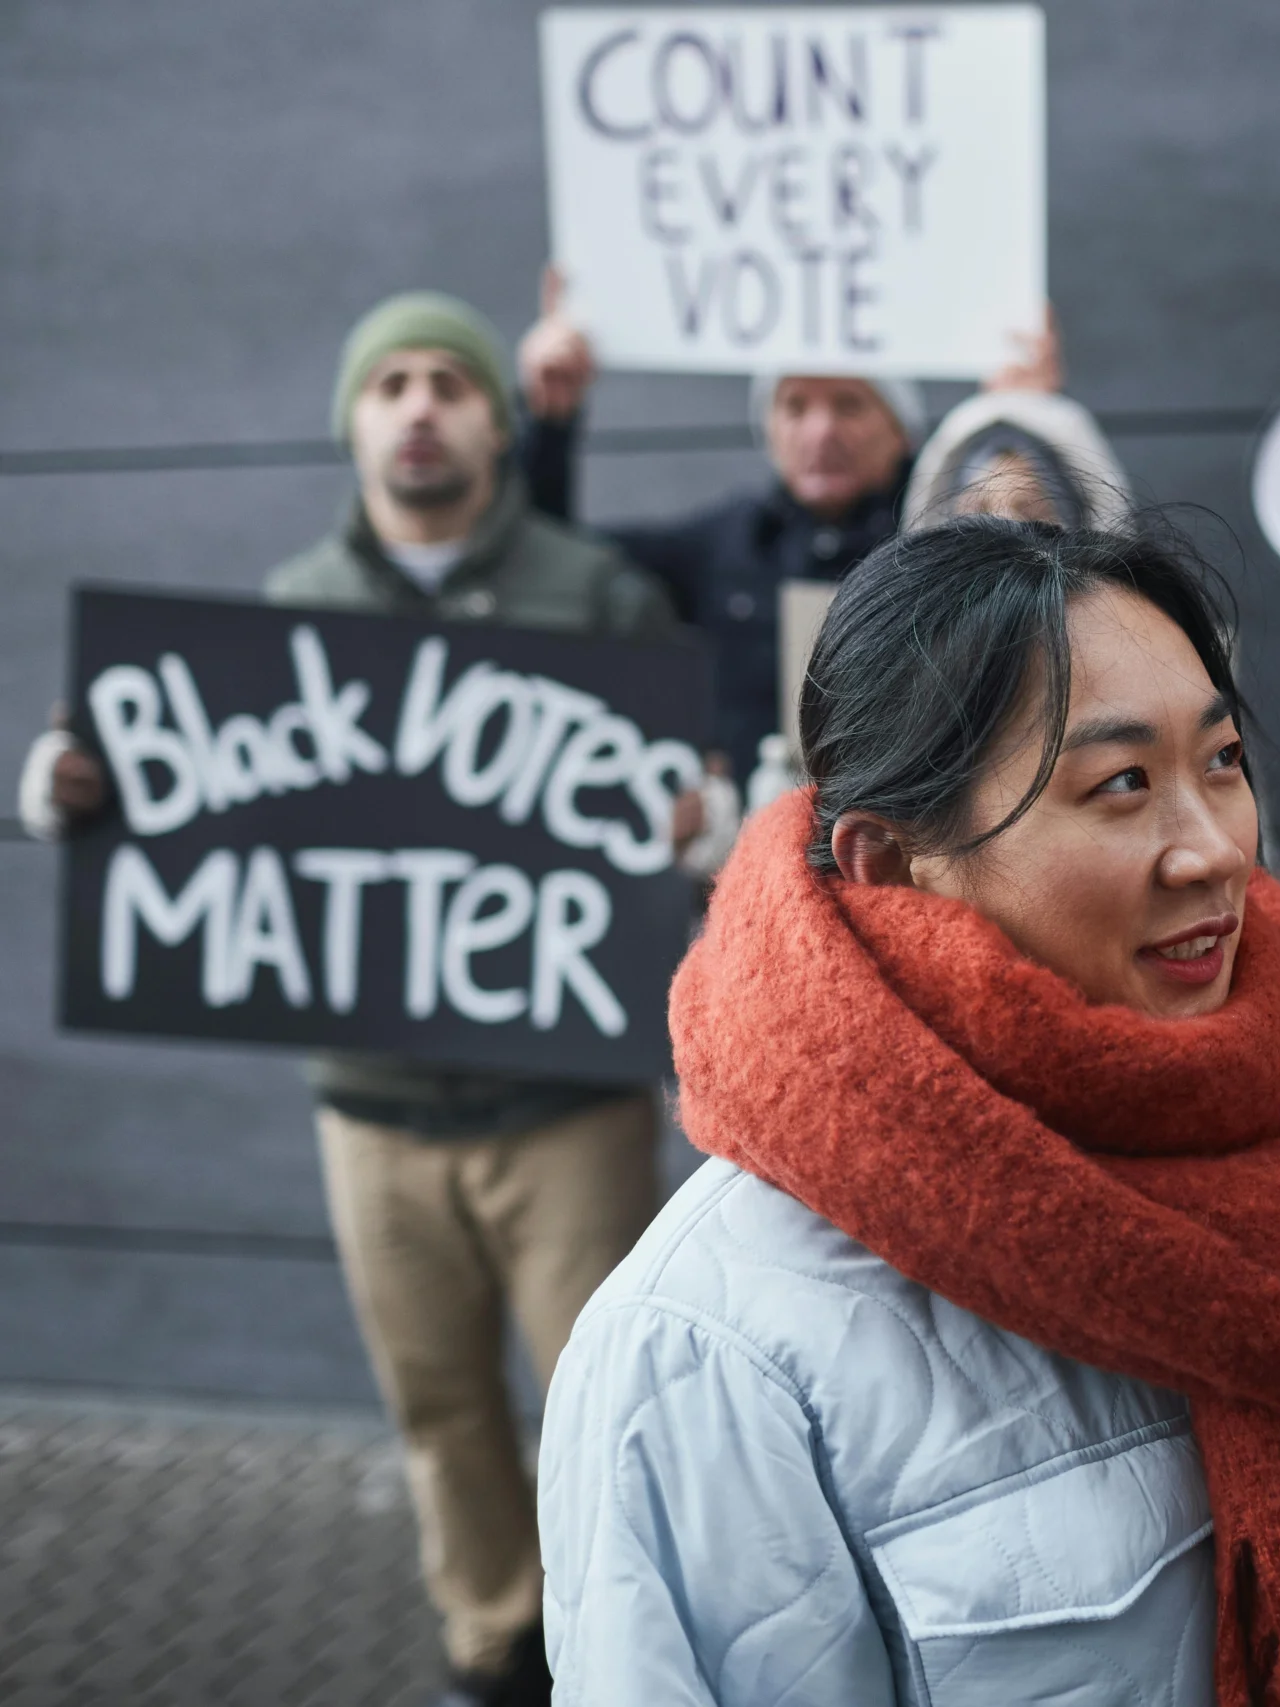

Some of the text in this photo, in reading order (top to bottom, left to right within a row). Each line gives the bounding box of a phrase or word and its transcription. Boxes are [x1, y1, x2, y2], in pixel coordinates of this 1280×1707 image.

[577, 25, 942, 142] COUNT
[639, 141, 938, 249] EVERY
[662, 247, 883, 353] VOTE
[89, 622, 388, 837] Black
